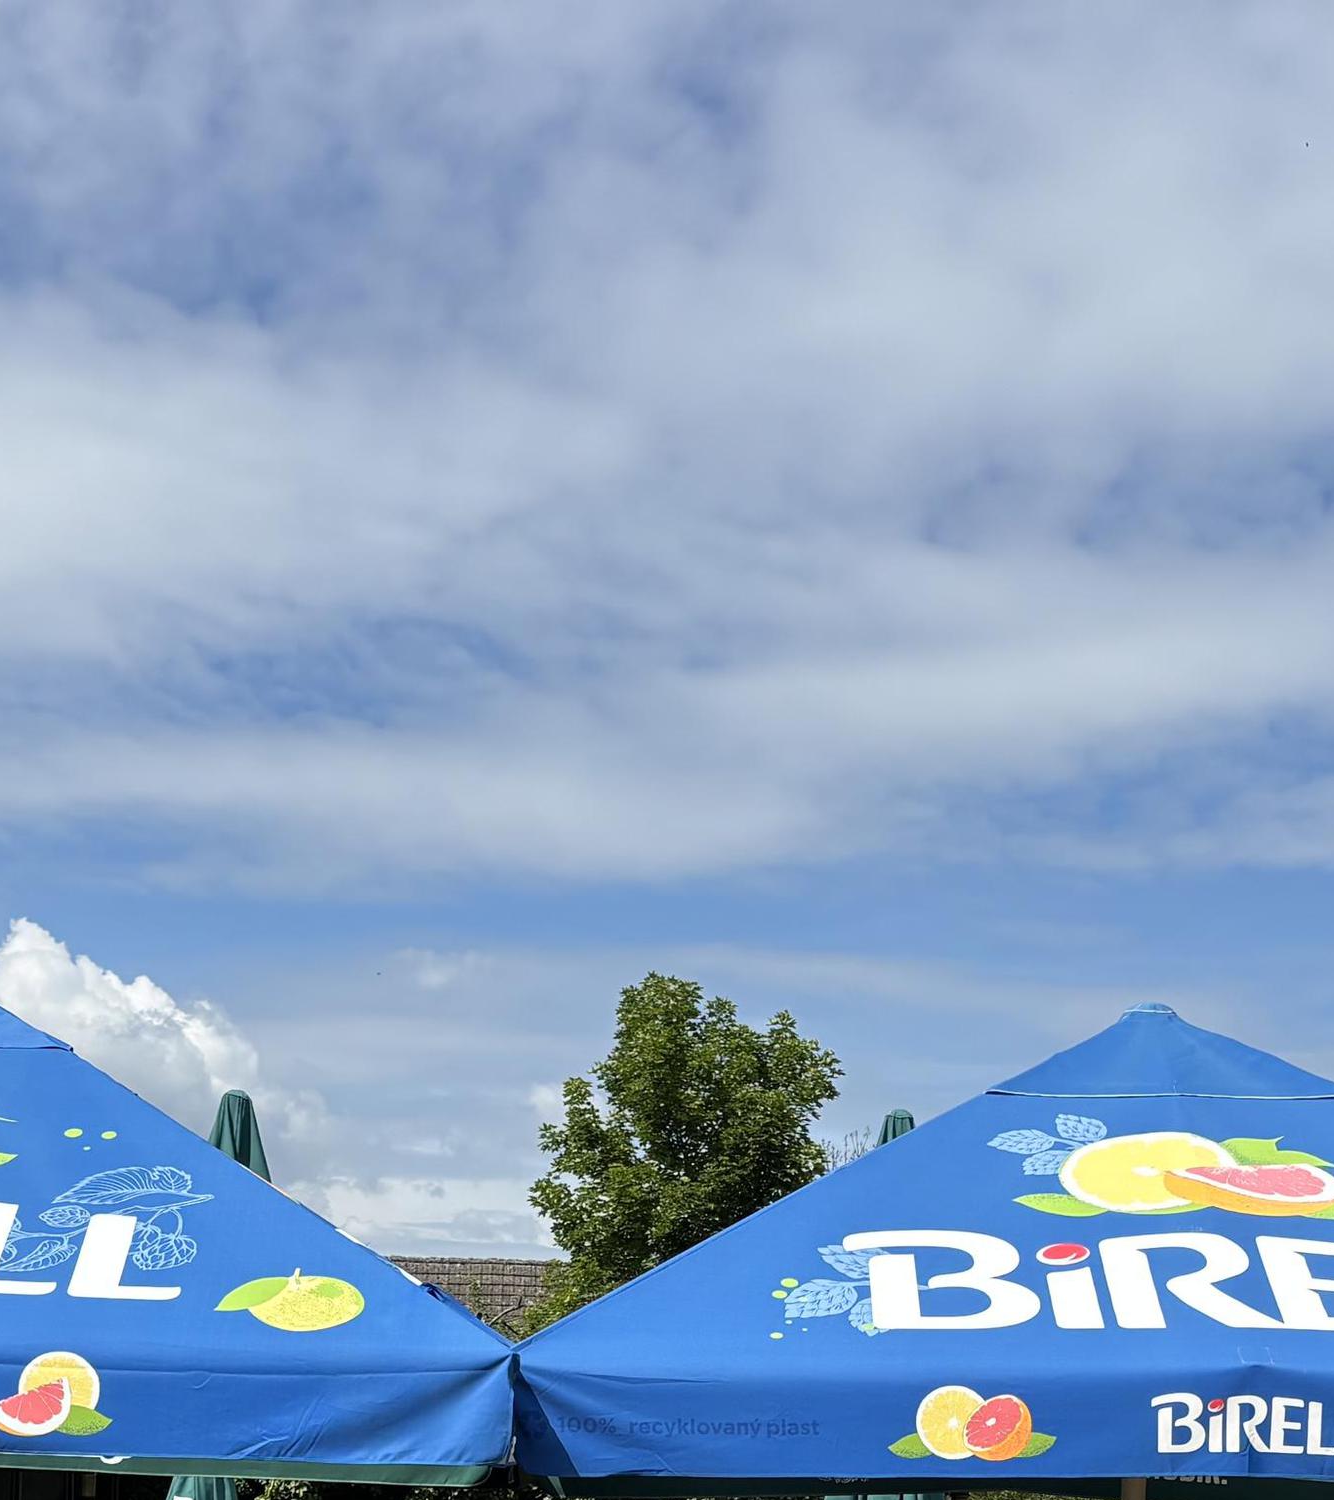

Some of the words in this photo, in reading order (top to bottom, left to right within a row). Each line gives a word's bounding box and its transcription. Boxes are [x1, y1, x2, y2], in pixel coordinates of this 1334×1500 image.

[558, 1416, 618, 1435] 100%
[629, 1417, 761, 1438] recyklovaný
[765, 1418, 822, 1439] plast
